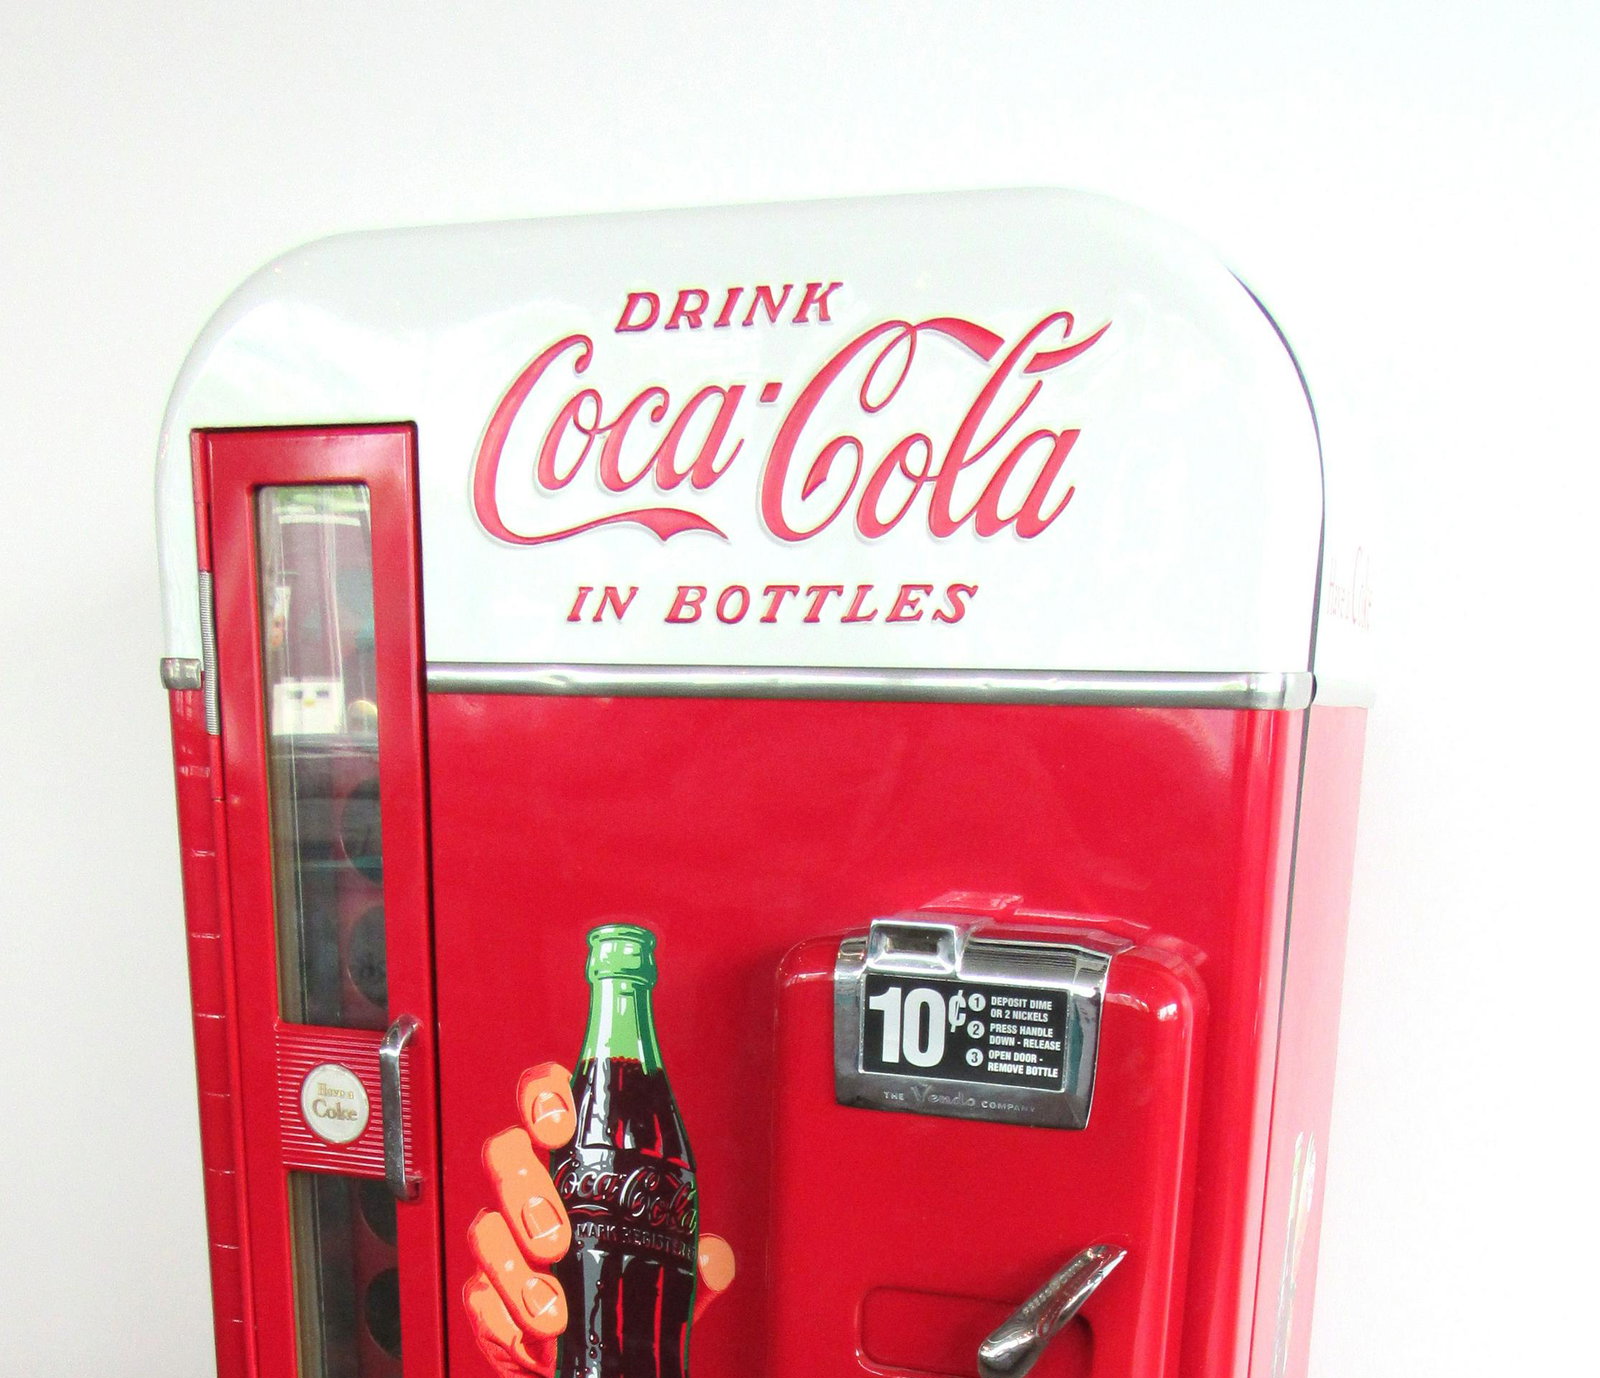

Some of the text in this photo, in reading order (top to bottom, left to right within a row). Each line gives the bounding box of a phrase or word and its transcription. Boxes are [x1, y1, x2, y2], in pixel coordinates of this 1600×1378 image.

[615, 281, 843, 333] DRINK
[473, 310, 1113, 545] Coca-Cola
[567, 583, 979, 625] IN BOTTLES
[990, 996, 1028, 1008] DEPOSIT
[1029, 999, 1053, 1010] DIME
[990, 1008, 1049, 1022] OR 2 NICKELS
[989, 1023, 1018, 1034] PRESS
[1019, 1025, 1054, 1038] HANDLE
[989, 1035, 1015, 1046] DOWN
[1023, 1038, 1061, 1051] RELEASE
[988, 1050, 1012, 1060] OPEN
[1013, 1052, 1037, 1063] DOOR
[987, 1061, 1059, 1078] REMOVE BOTTLE
[883, 1085, 1036, 1113] THE Vendo COMPANY
[312, 1099, 358, 1120] Coke
